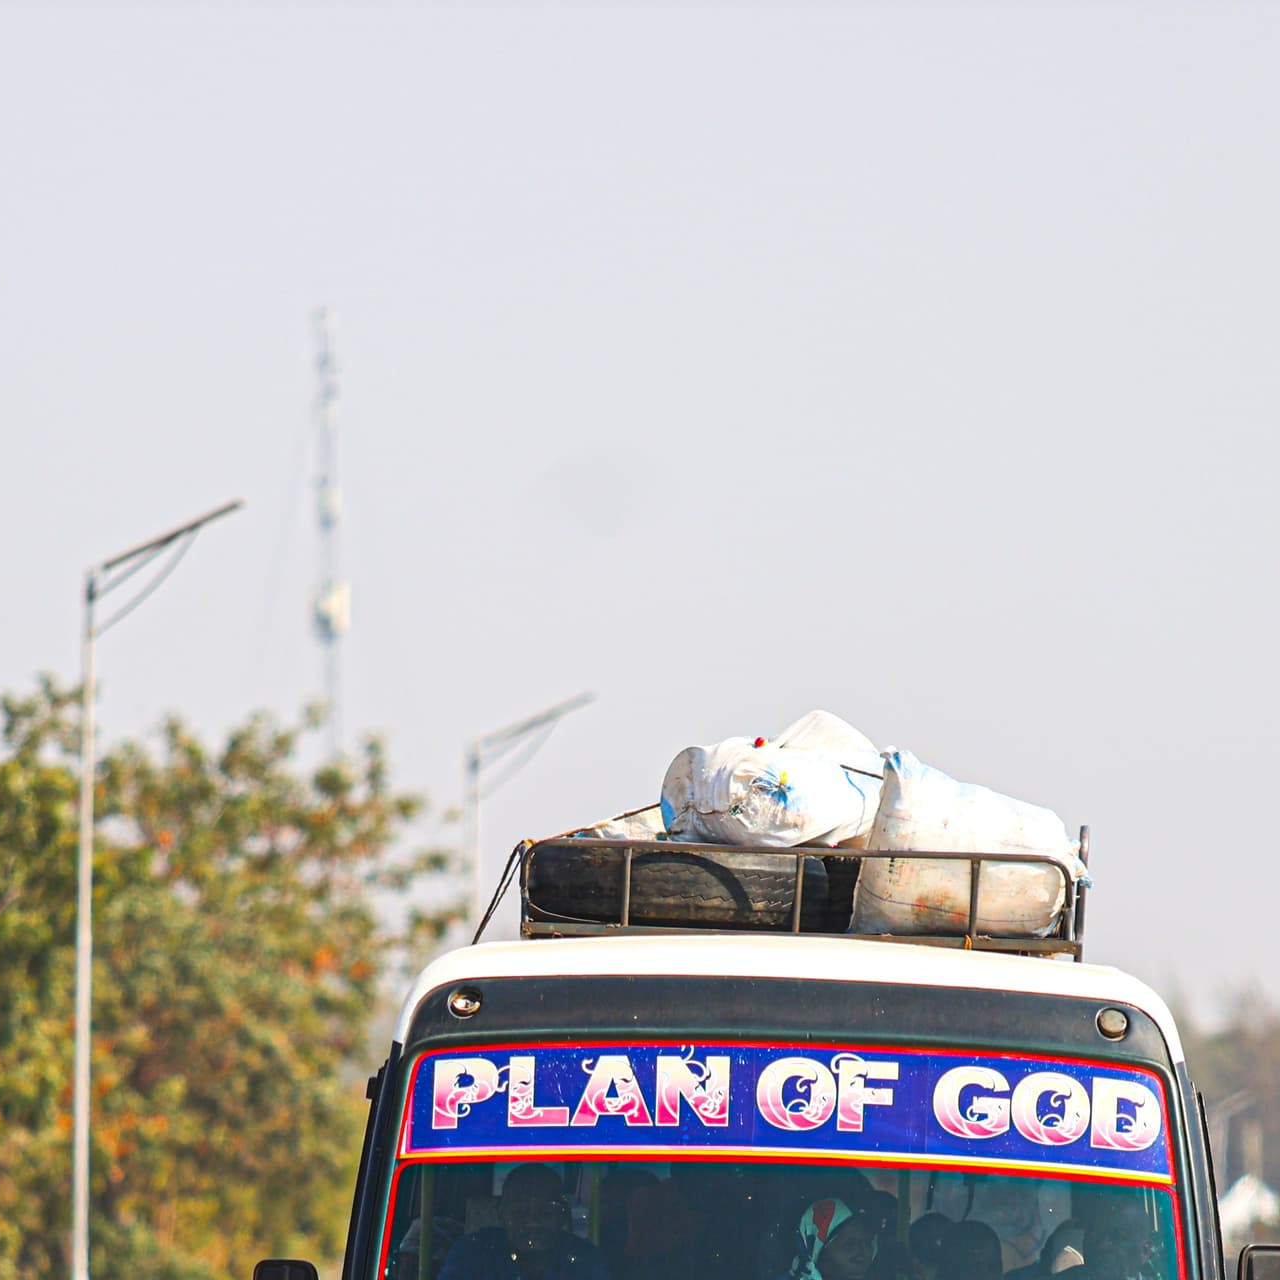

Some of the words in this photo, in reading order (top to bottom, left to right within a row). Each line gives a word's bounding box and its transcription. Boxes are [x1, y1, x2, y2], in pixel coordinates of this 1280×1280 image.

[431, 1051, 731, 1130] PLAN
[756, 1053, 900, 1133] OF
[932, 1065, 1163, 1152] GOD
